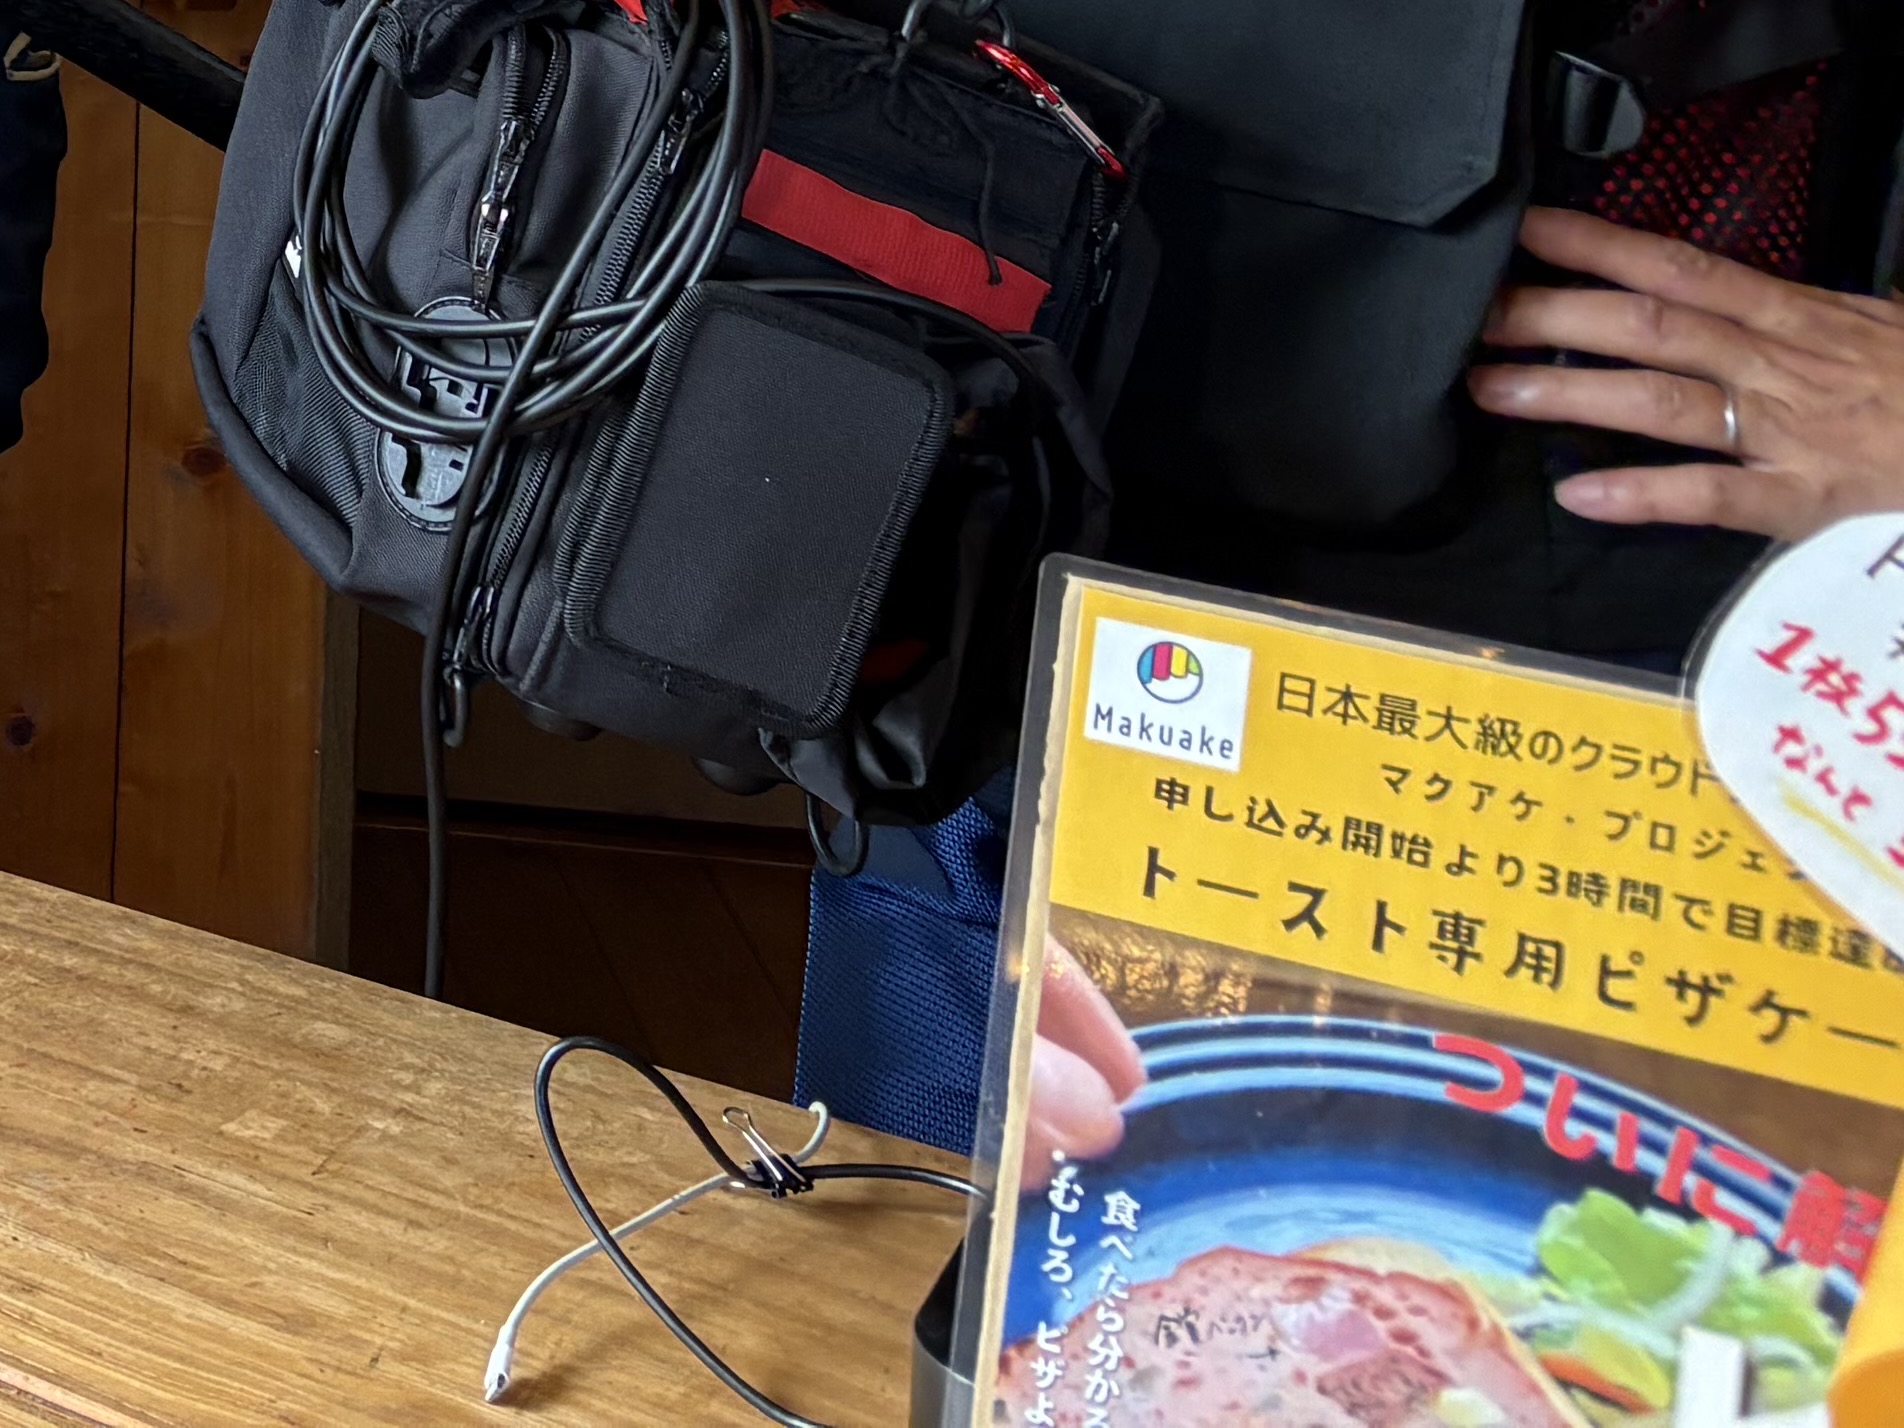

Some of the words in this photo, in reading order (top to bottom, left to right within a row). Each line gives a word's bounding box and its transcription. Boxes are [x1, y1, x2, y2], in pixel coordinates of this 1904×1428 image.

[1093, 702, 1235, 761] Makuake
[1275, 672, 1740, 804] 日本最大級のクラウド
[1377, 761, 1807, 881] マクアケ・プロジェ
